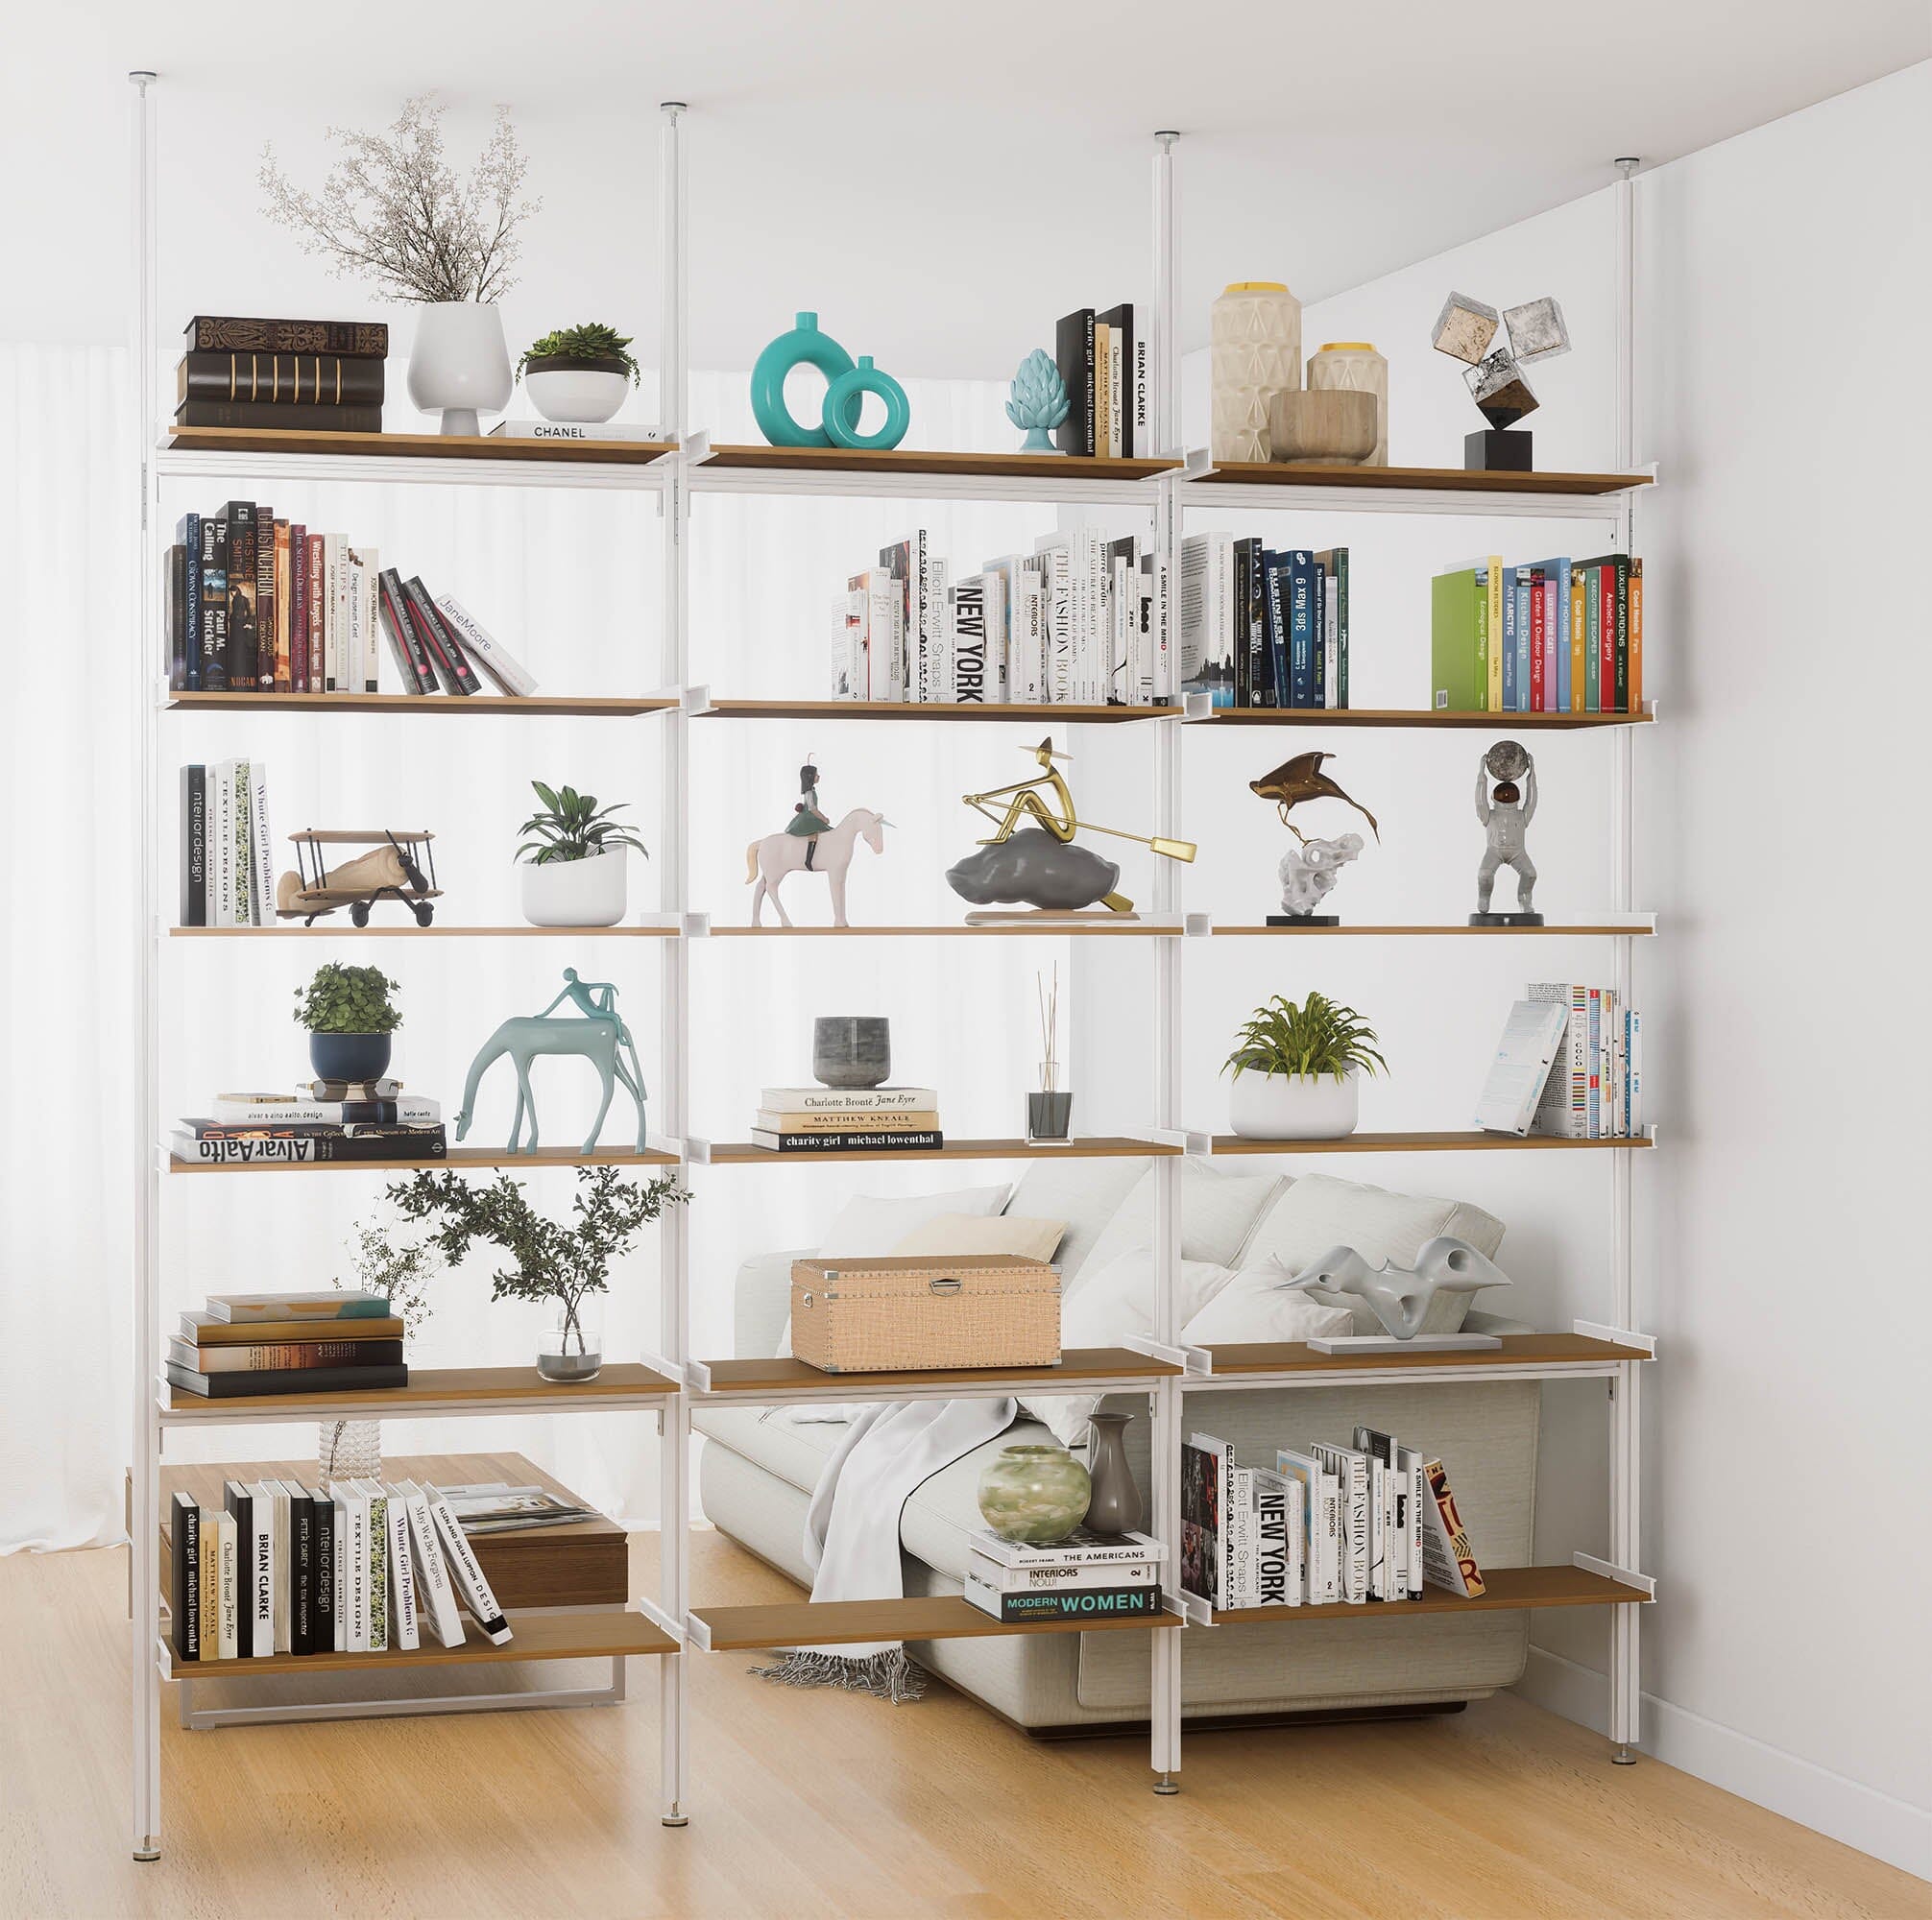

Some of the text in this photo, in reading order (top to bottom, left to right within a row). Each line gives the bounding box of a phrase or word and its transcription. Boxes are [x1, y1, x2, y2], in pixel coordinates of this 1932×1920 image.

[534, 426, 586, 438] CHANEL
[1112, 407, 1121, 425] Jane
[203, 522, 215, 561] Calling
[216, 522, 226, 543] The
[232, 539, 242, 572] SMITH
[257, 513, 273, 596] GEOSYNCHRON
[311, 540, 321, 579] Wrestling
[188, 561, 197, 639] CROWN CONSPIRACY
[296, 577, 304, 610] DUCHESS
[313, 580, 322, 598] with
[350, 573, 359, 594] Design
[1295, 588, 1306, 610] Max
[311, 599, 321, 626] Angels
[1161, 601, 1167, 610] IN
[1272, 567, 1284, 645] BUSINESS
[1295, 612, 1306, 632] 3ds
[204, 610, 214, 656] Strickler
[216, 610, 226, 651] Paul M.
[930, 561, 943, 687] Elliott Erwitt Snaps
[1056, 551, 1068, 702] THE FASHION BOOK
[1534, 590, 1542, 683] Garden Outdoor Design
[956, 588, 983, 704] NEW YORK
[1519, 630, 1528, 660] Design
[1605, 628, 1613, 661] Surgery
[1028, 683, 1035, 691] 2
[259, 824, 273, 900] Girl Problems
[302, 1111, 324, 1120] design
[805, 1094, 916, 1107] Charlotte Brontë Jane Eyre
[786, 1134, 934, 1147] charity girl michael lowenthal
[1415, 1500, 1422, 1509] IN
[300, 1518, 308, 1541] PETER
[439, 1506, 478, 1582] ELLEN AND JULIA LUPTON
[1236, 1473, 1248, 1593] Elliott Erwitt Snaps
[1353, 1456, 1365, 1601] THE FASHION BOOK
[224, 1542, 232, 1576] Charlotte
[300, 1543, 308, 1568] CAREY
[415, 1505, 444, 1590] May We Be Forgiven
[1086, 1551, 1146, 1560] AMERICANS
[1260, 1494, 1285, 1604] NEW YORK
[187, 1513, 197, 1652] charity girl michael lowenthal
[258, 1534, 269, 1620] BRIAN CLARKE
[1029, 1568, 1078, 1578] INTERIORS
[401, 1553, 413, 1627] Girl Problems
[1008, 1596, 1058, 1609] MODERN
[1061, 1593, 1144, 1613] WOMEN
[223, 1604, 233, 1622] Jane
[299, 1602, 307, 1636] inspector
[226, 1623, 234, 1640] Eyre
